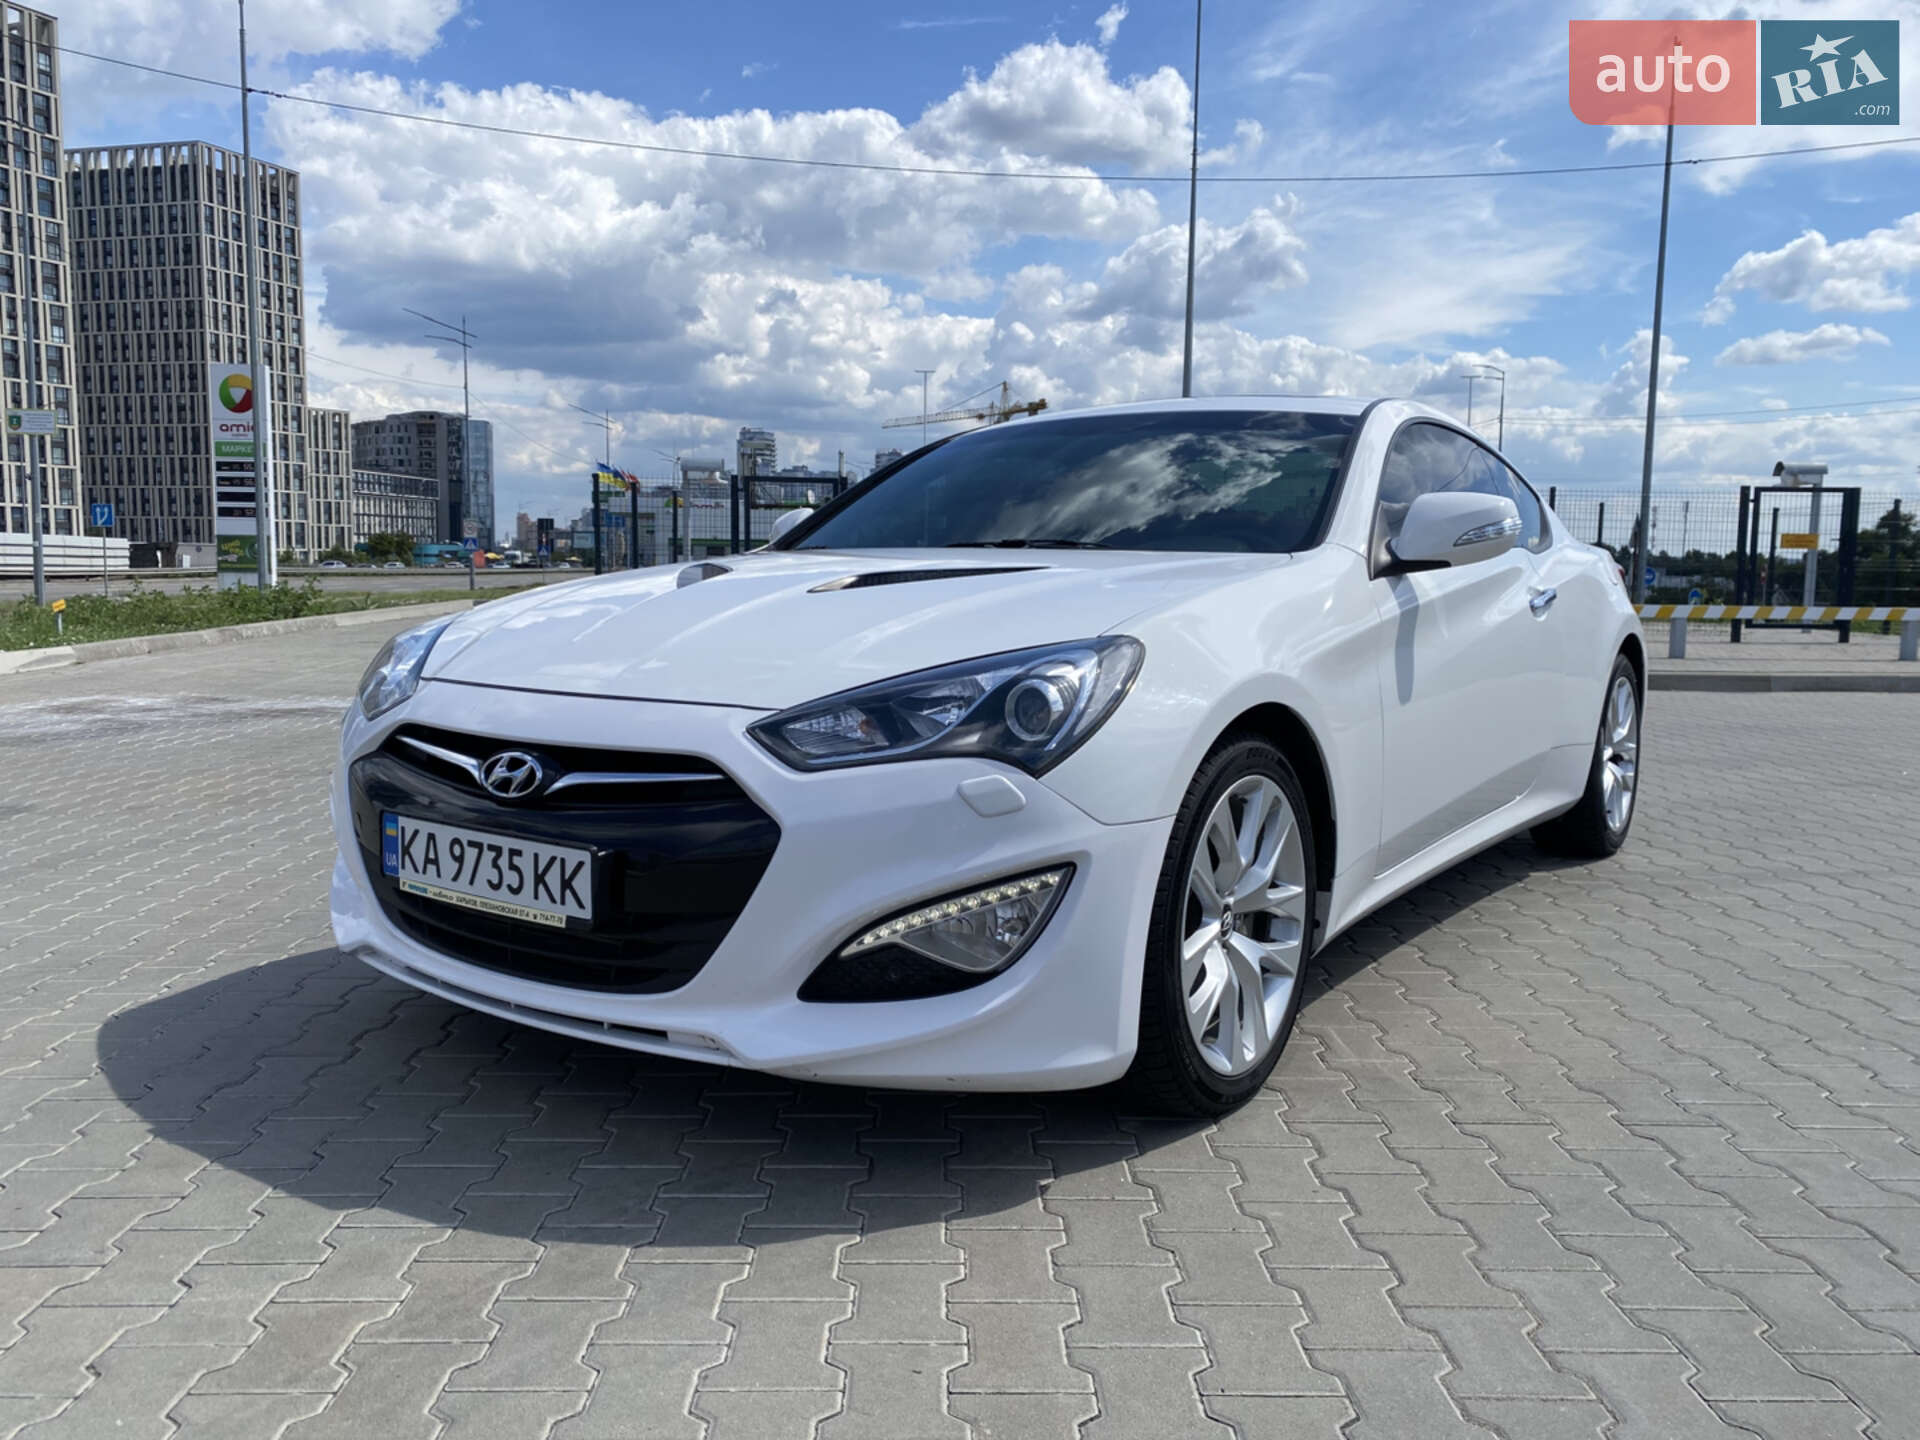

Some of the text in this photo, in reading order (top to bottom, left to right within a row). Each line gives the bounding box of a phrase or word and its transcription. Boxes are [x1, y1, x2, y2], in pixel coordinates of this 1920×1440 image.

[222, 444, 254, 453] МАРКЕ
[386, 851, 398, 867] UA
[401, 826, 585, 910] KA 9735 KK
